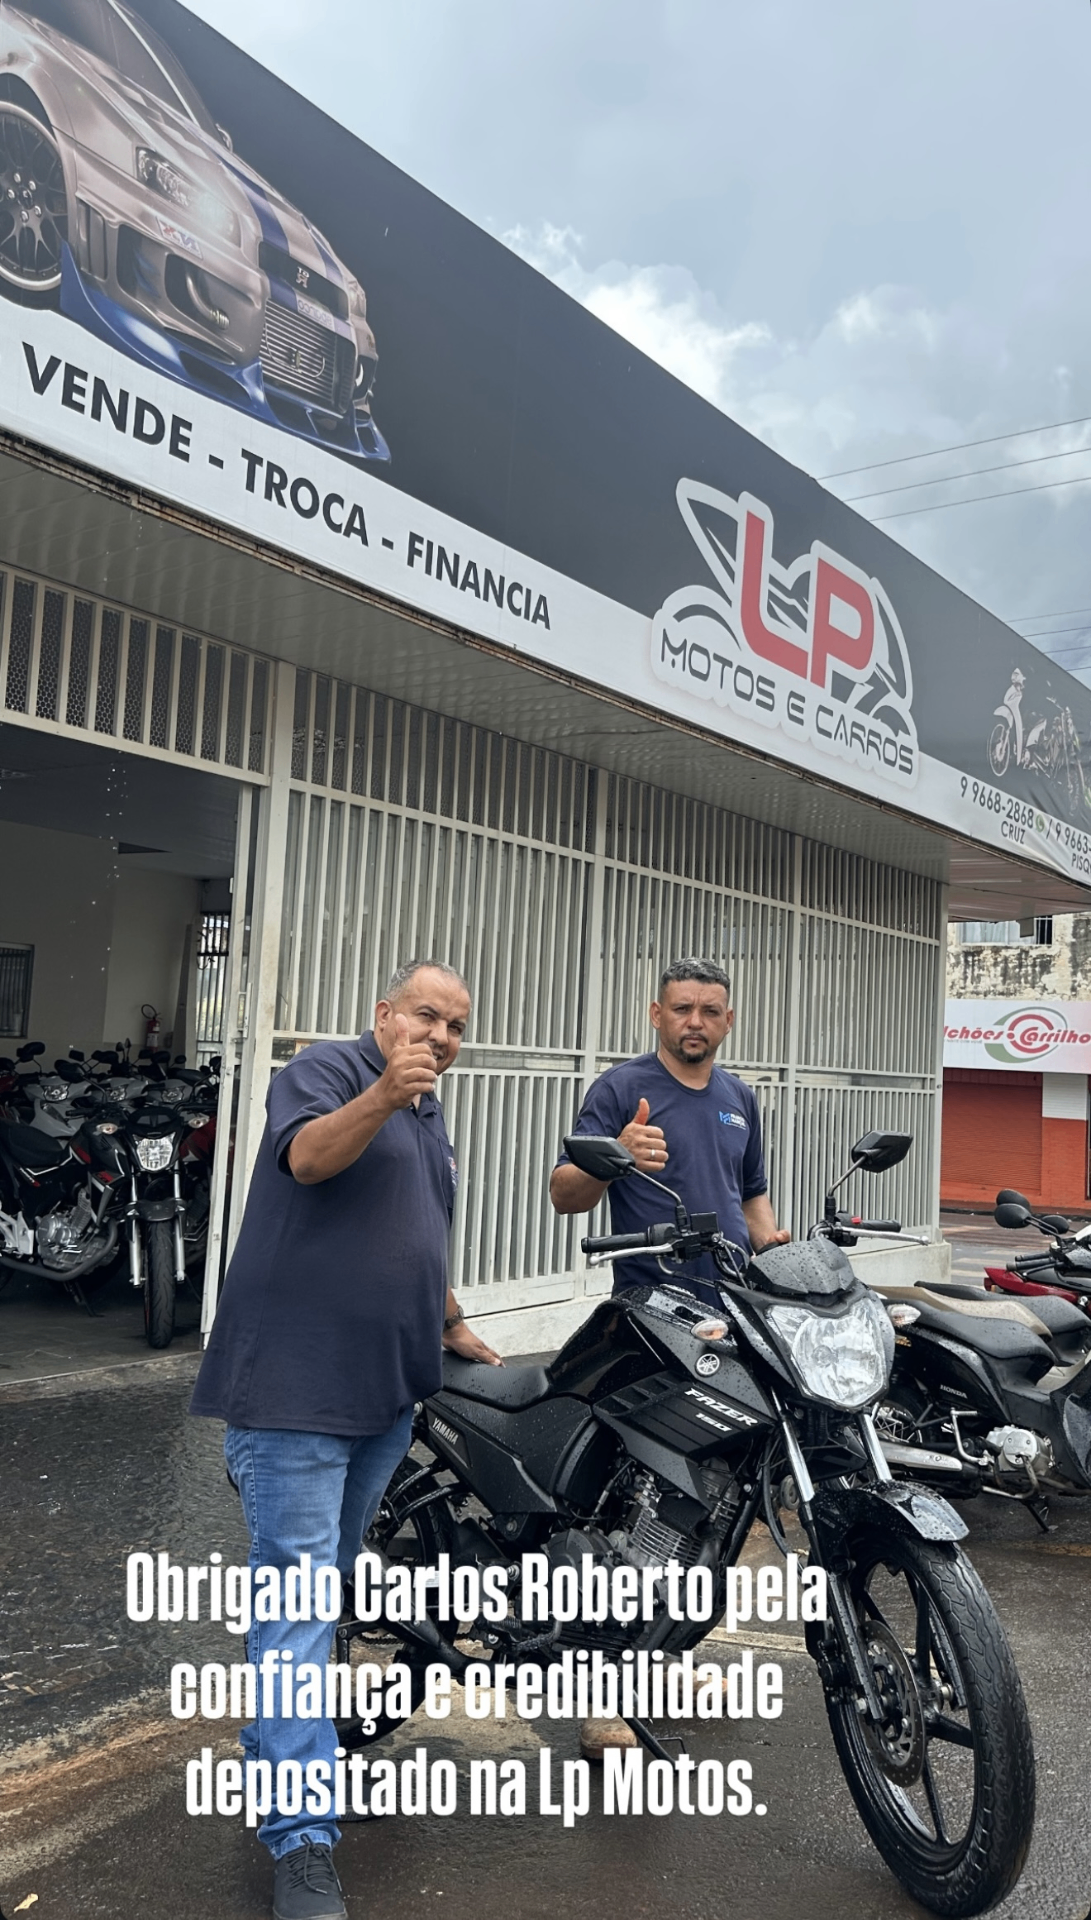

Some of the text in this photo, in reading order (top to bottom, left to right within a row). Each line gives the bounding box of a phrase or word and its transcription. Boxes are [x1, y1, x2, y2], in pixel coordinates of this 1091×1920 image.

[22, 341, 193, 463] VENDE
[241, 448, 369, 547] TROCA
[407, 531, 551, 630] FINANCIA
[741, 510, 875, 689] LP
[661, 628, 914, 775] MOTOS E CARROS
[960, 776, 968, 798] 9
[972, 781, 1034, 829] 9668-2868
[1055, 822, 1062, 841] 9
[1001, 820, 1026, 845] CRUZ
[1071, 852, 1091, 875] PISQ
[684, 1387, 758, 1427] FAZER
[940, 1384, 968, 1399] HONDA
[432, 1417, 459, 1445] YAMAHA
